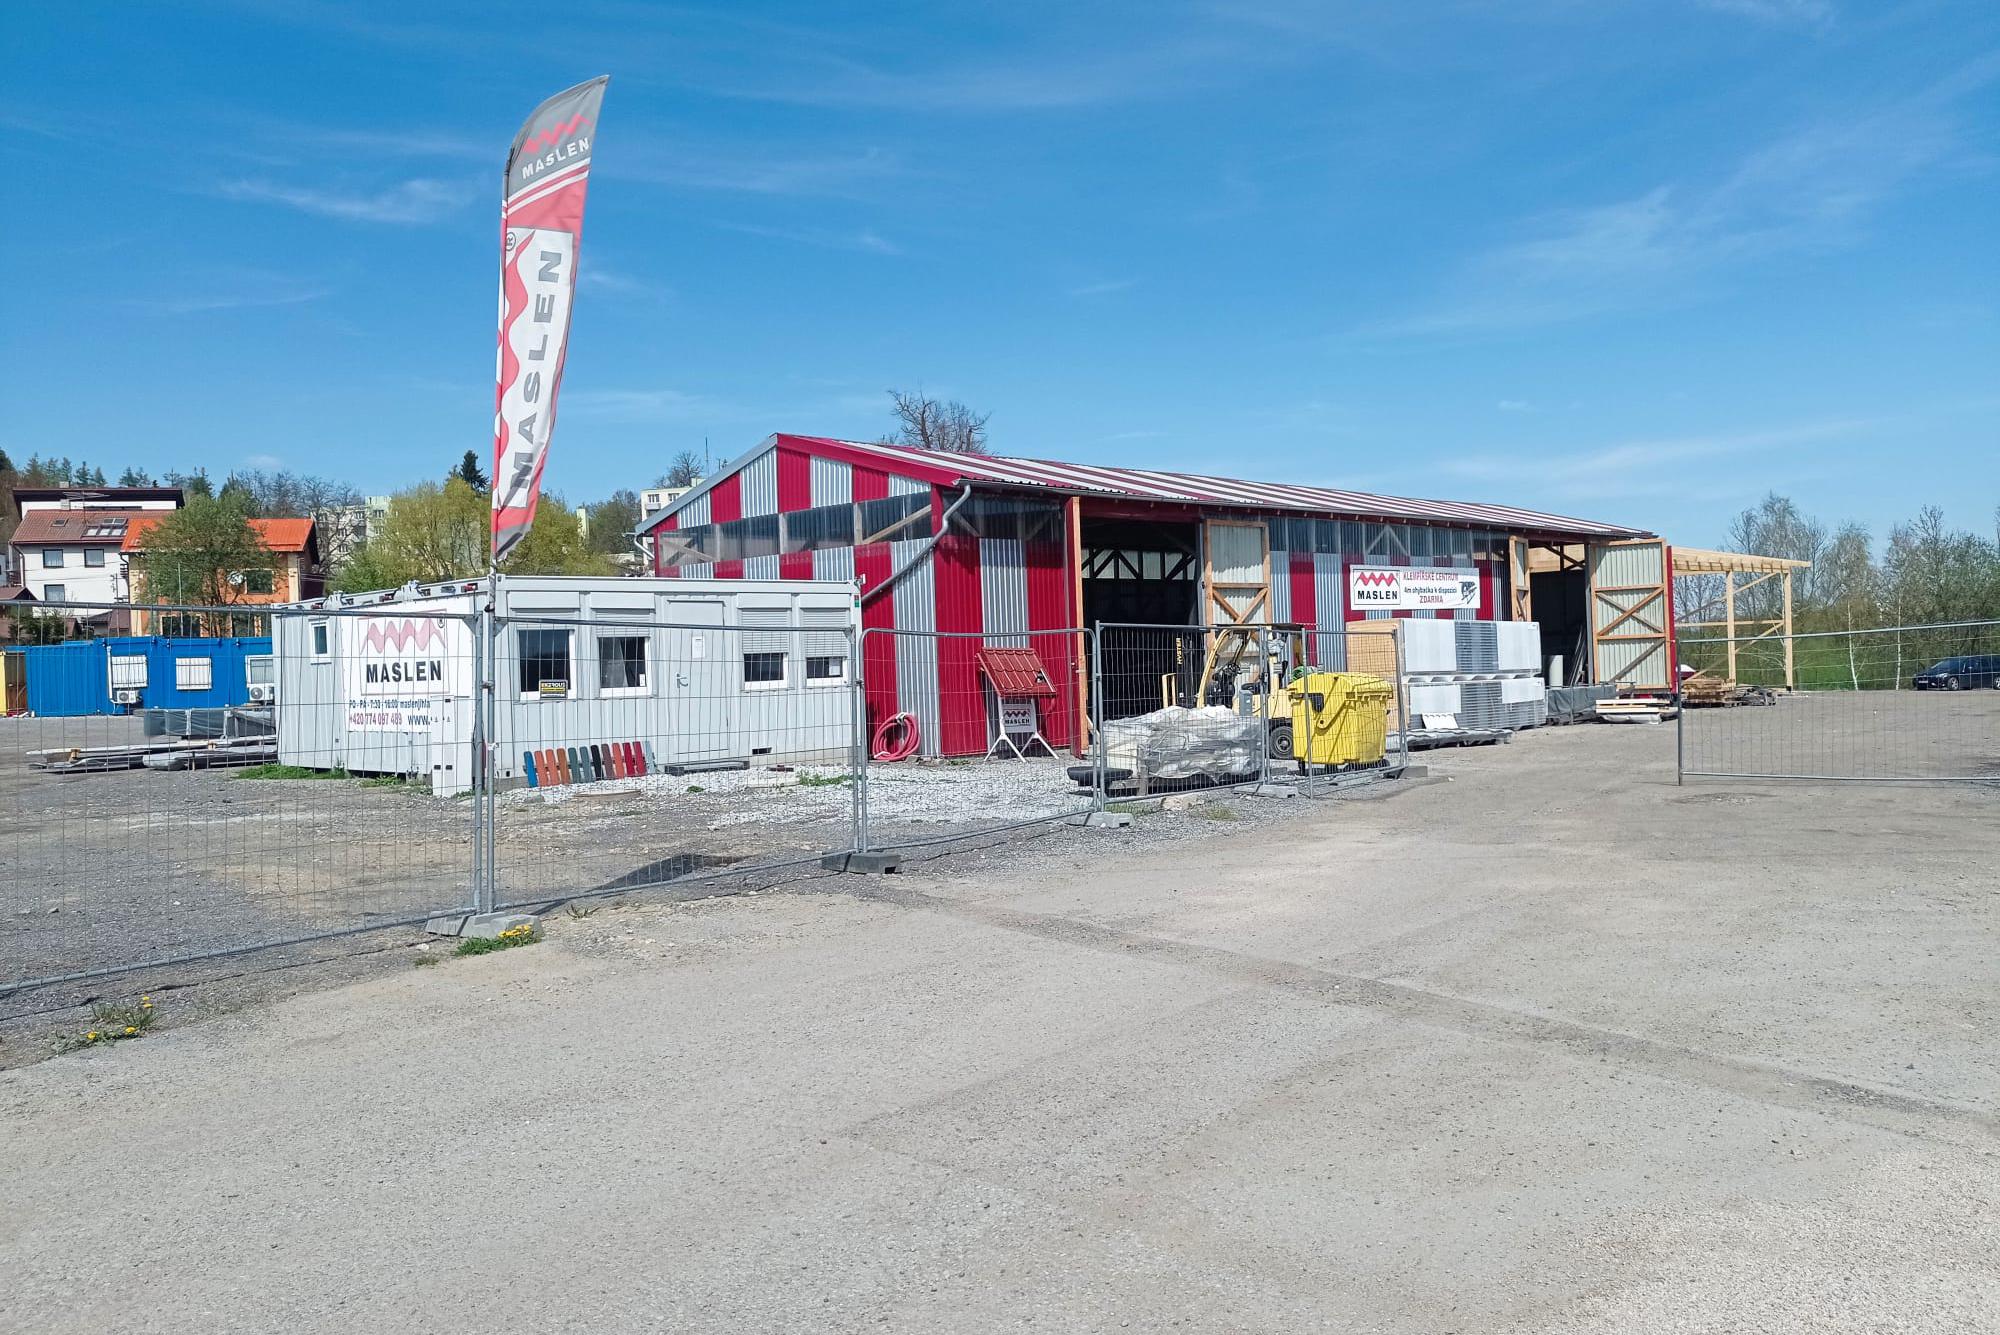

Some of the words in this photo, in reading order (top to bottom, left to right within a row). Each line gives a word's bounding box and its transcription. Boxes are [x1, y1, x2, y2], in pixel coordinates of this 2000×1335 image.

[522, 138, 590, 180] MASLEN
[510, 250, 562, 489] MASLEN
[1357, 590, 1398, 600] MASLEN
[1419, 595, 1444, 604] ZDARMA
[366, 660, 442, 683] MASLEN
